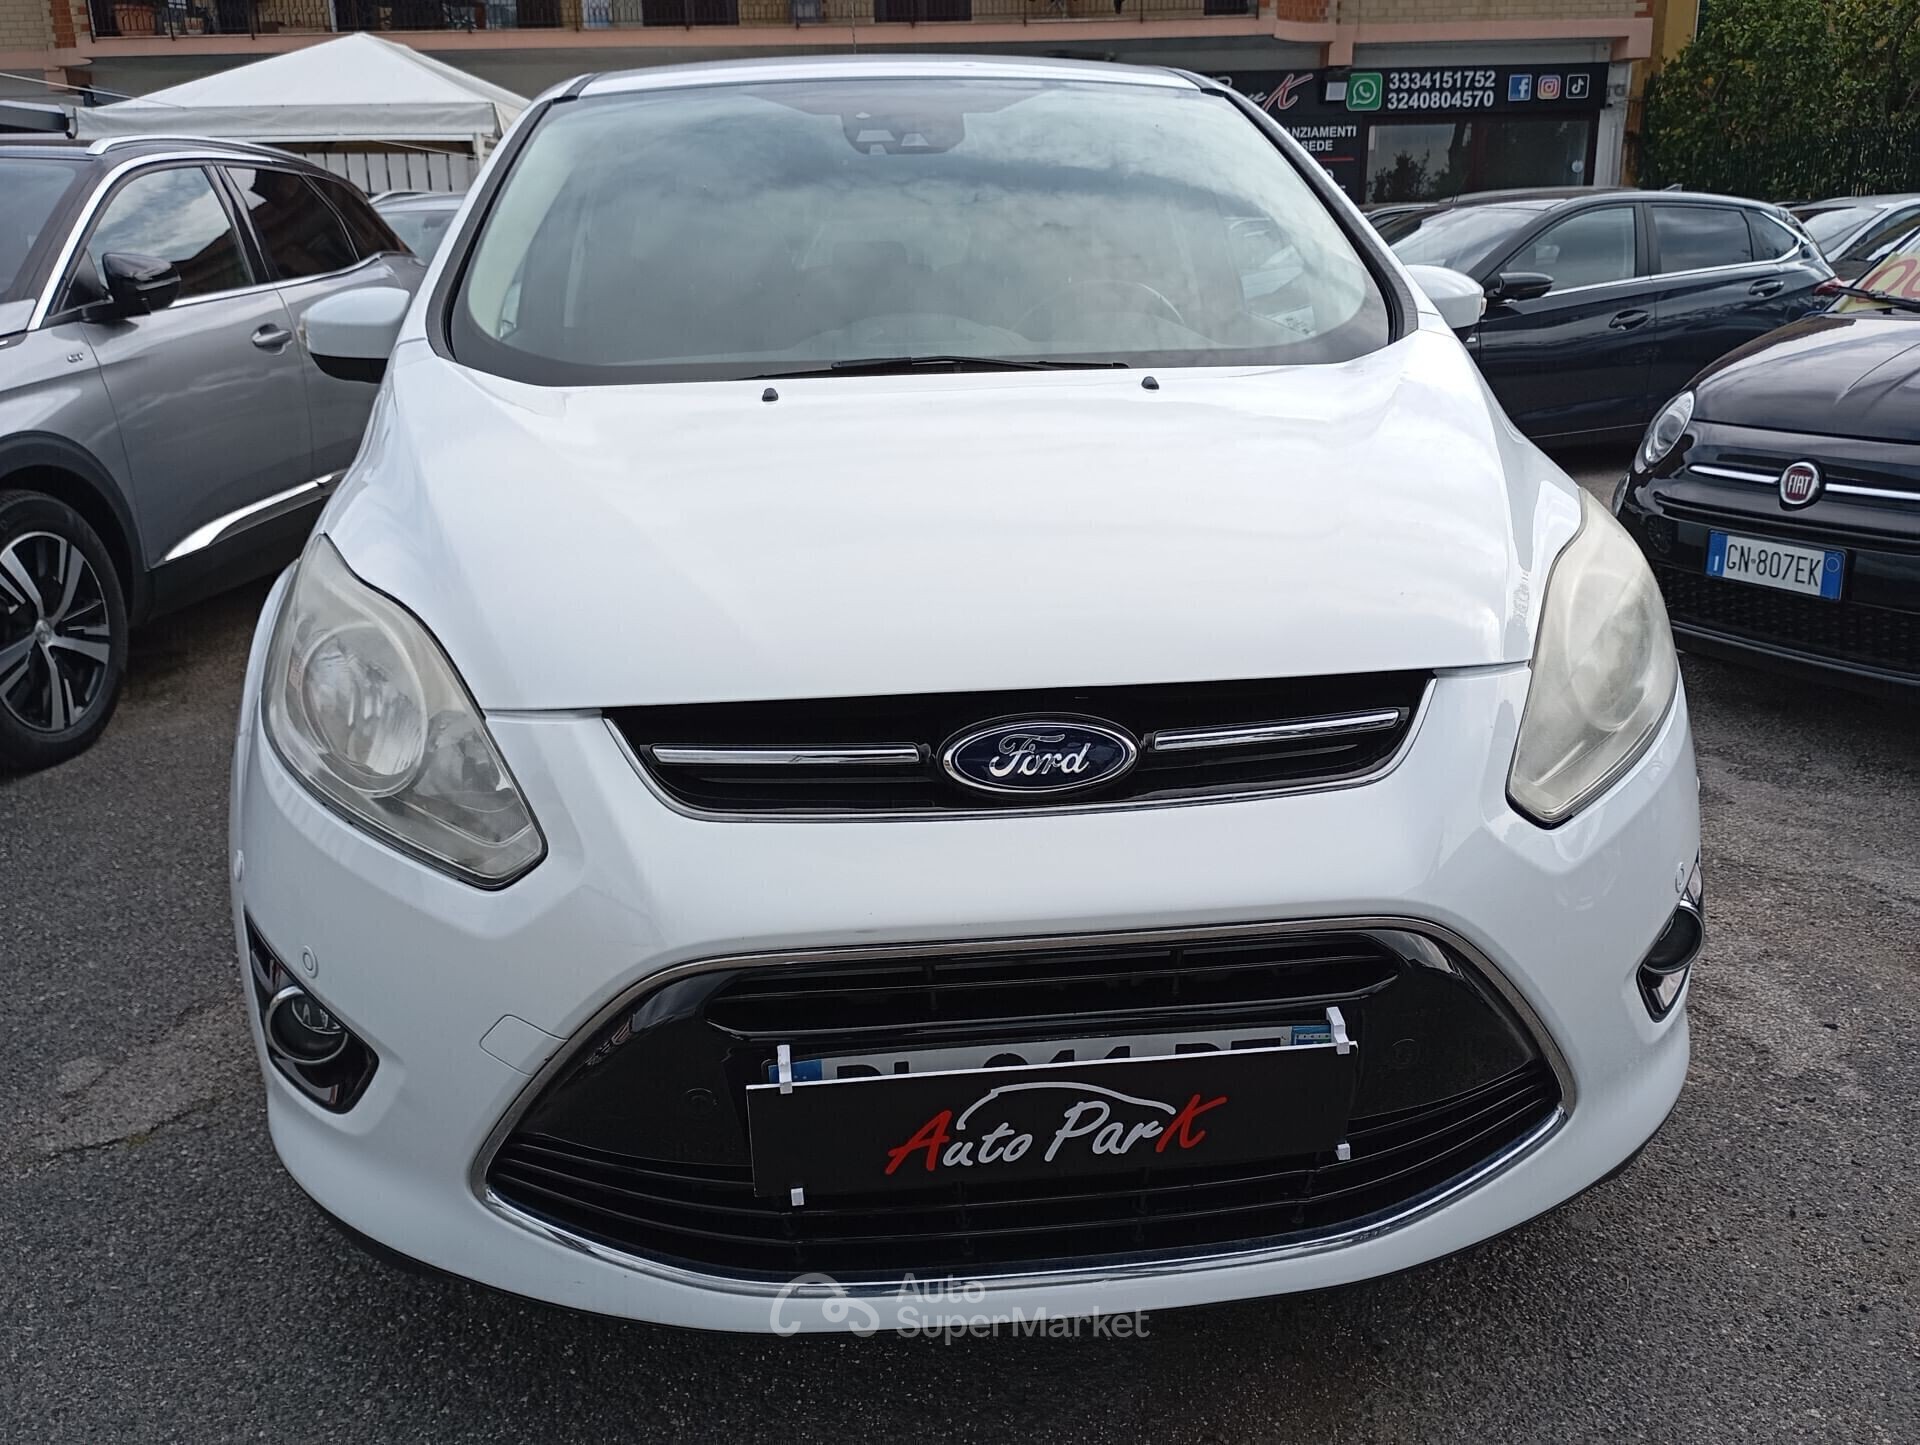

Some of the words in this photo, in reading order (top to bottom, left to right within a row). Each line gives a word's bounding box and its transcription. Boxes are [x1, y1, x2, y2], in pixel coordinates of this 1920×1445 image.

[1389, 70, 1496, 89] 3334151752
[1387, 90, 1495, 110] 3240804570
[1787, 473, 1812, 495] FIAT
[988, 733, 1092, 778] Ford
[885, 1110, 1033, 1175] Auto
